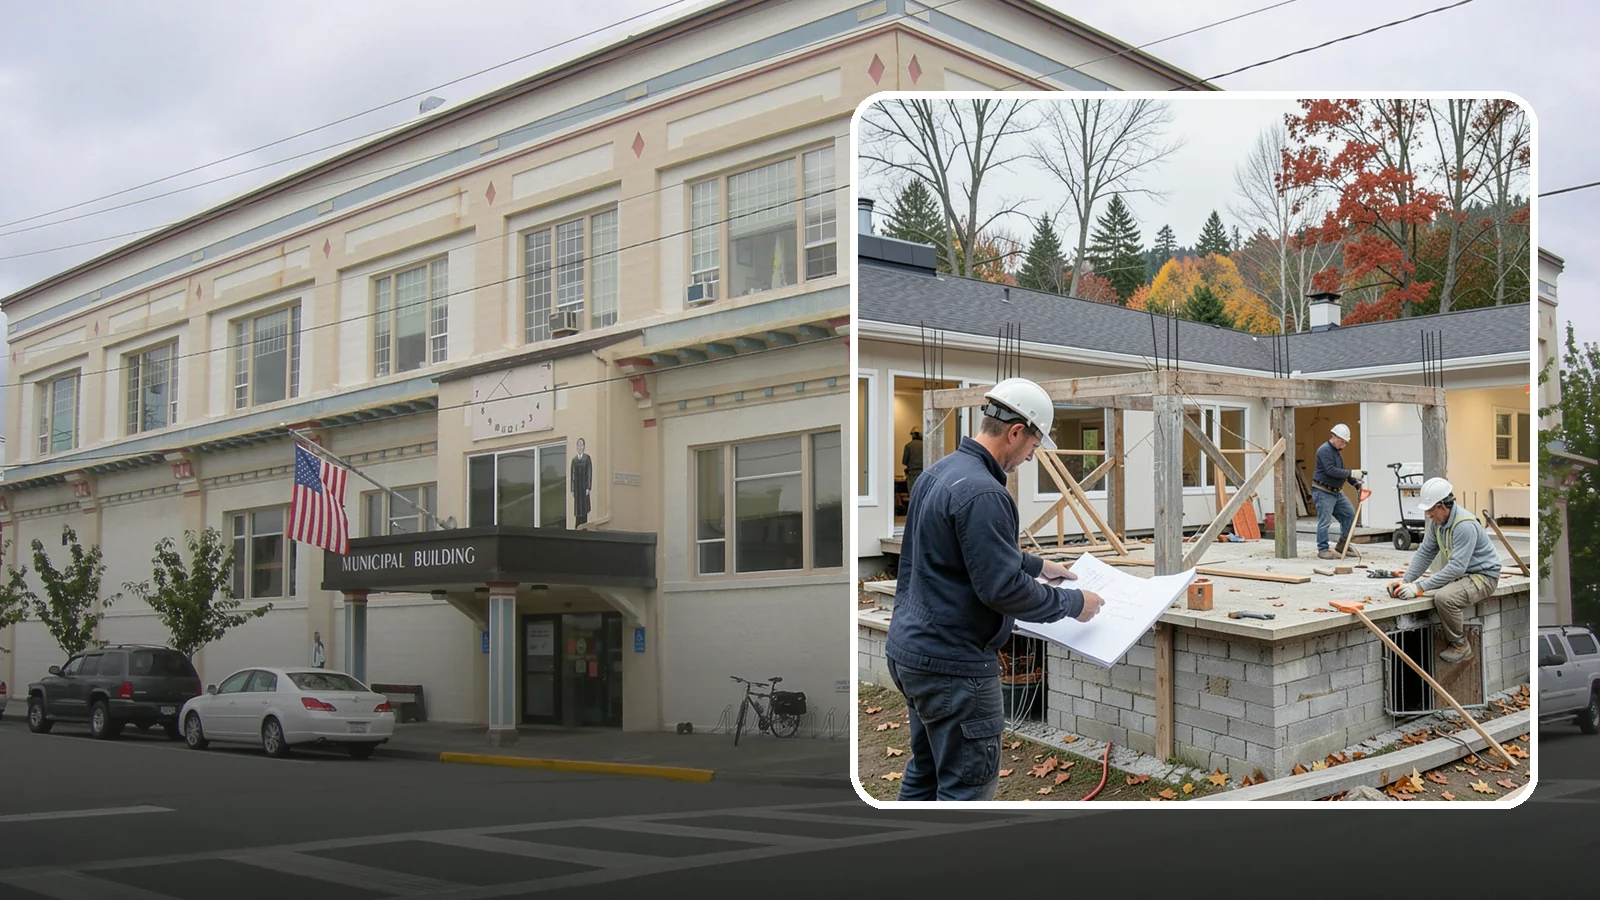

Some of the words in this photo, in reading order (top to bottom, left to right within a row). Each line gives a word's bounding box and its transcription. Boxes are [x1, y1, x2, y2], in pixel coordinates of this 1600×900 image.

[536, 402, 540, 410] 4
[480, 407, 485, 415] 8
[487, 417, 493, 426] 9
[529, 414, 533, 422] 3
[494, 423, 500, 432] 10
[521, 420, 526, 428] 2
[501, 425, 506, 434] 11
[507, 425, 513, 434] 12
[342, 552, 405, 572] MUNICIPAL
[414, 546, 475, 567] BUILDING
